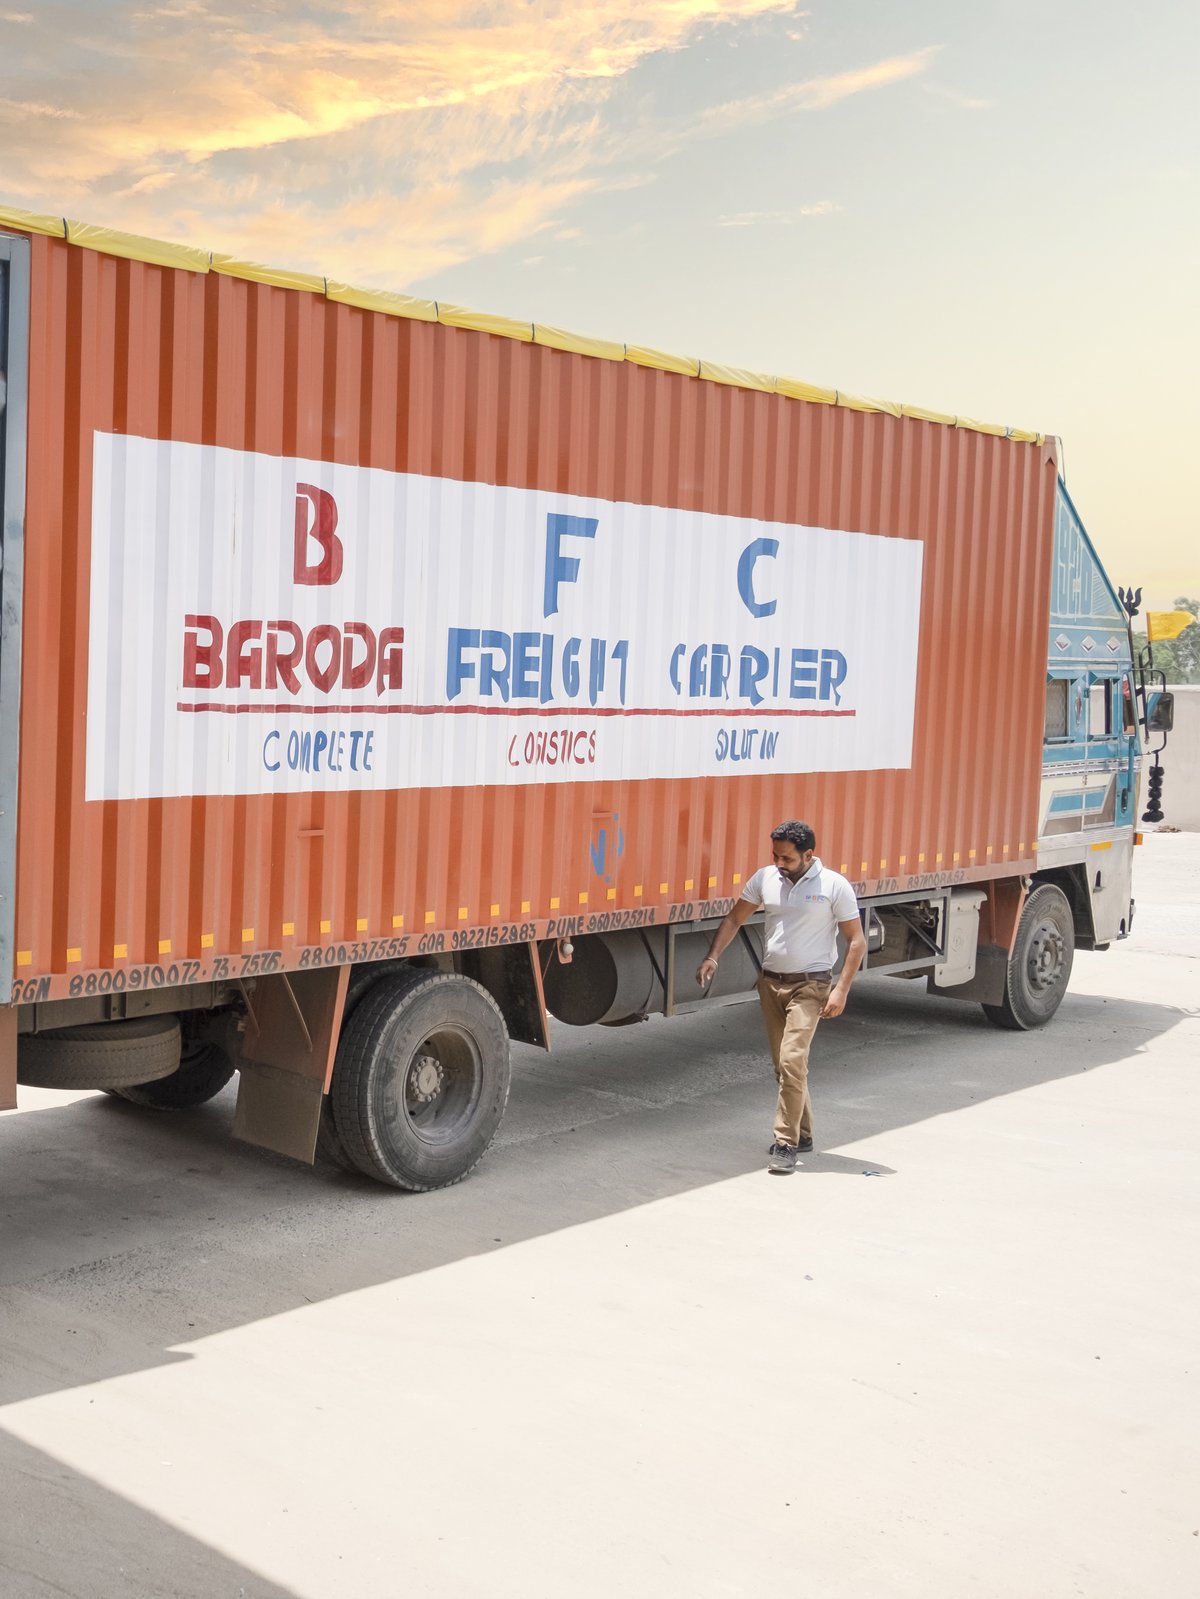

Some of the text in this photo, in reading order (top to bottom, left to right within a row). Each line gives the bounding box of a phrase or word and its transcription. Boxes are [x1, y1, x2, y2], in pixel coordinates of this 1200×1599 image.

[294, 484, 779, 619] B F C
[183, 615, 404, 695] BARODA
[669, 643, 847, 706] CARRIER
[262, 729, 374, 772] COMPLETE
[417, 933, 445, 954] GOA
[546, 915, 585, 938] PUNE
[668, 902, 694, 922] BRD
